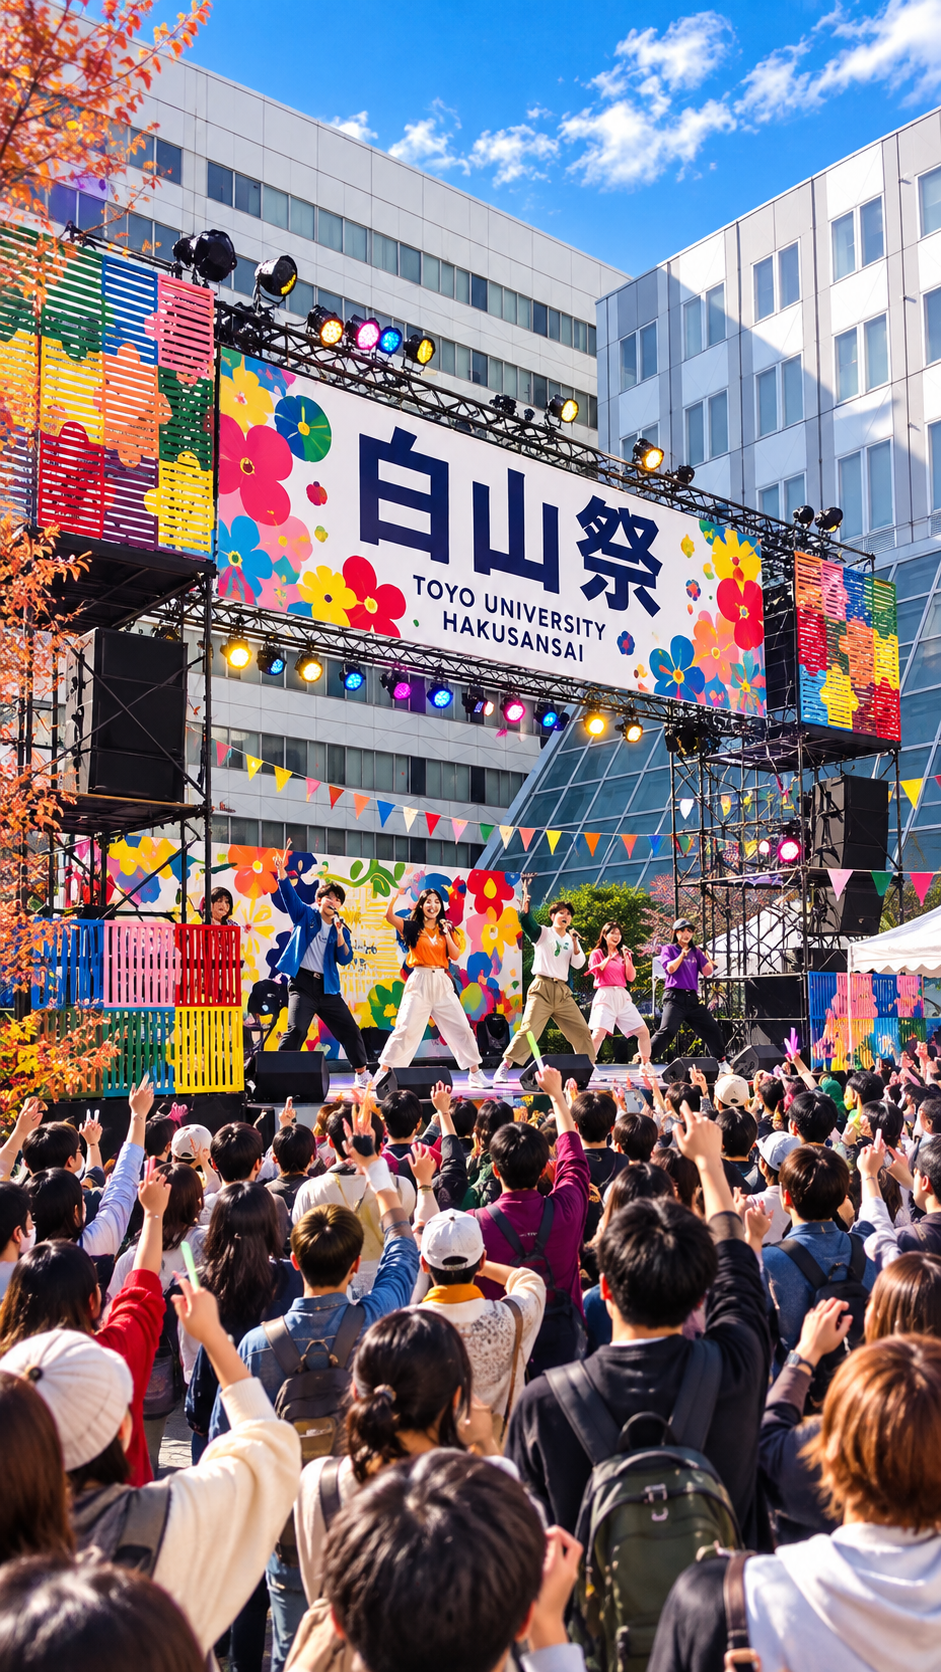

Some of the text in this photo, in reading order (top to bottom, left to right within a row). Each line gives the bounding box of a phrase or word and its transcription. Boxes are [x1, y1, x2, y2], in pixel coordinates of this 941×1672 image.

[358, 425, 663, 617] 白山祭
[413, 574, 607, 641] TOYO UNIVERSITY
[443, 610, 584, 662] HAKUSANSAI
